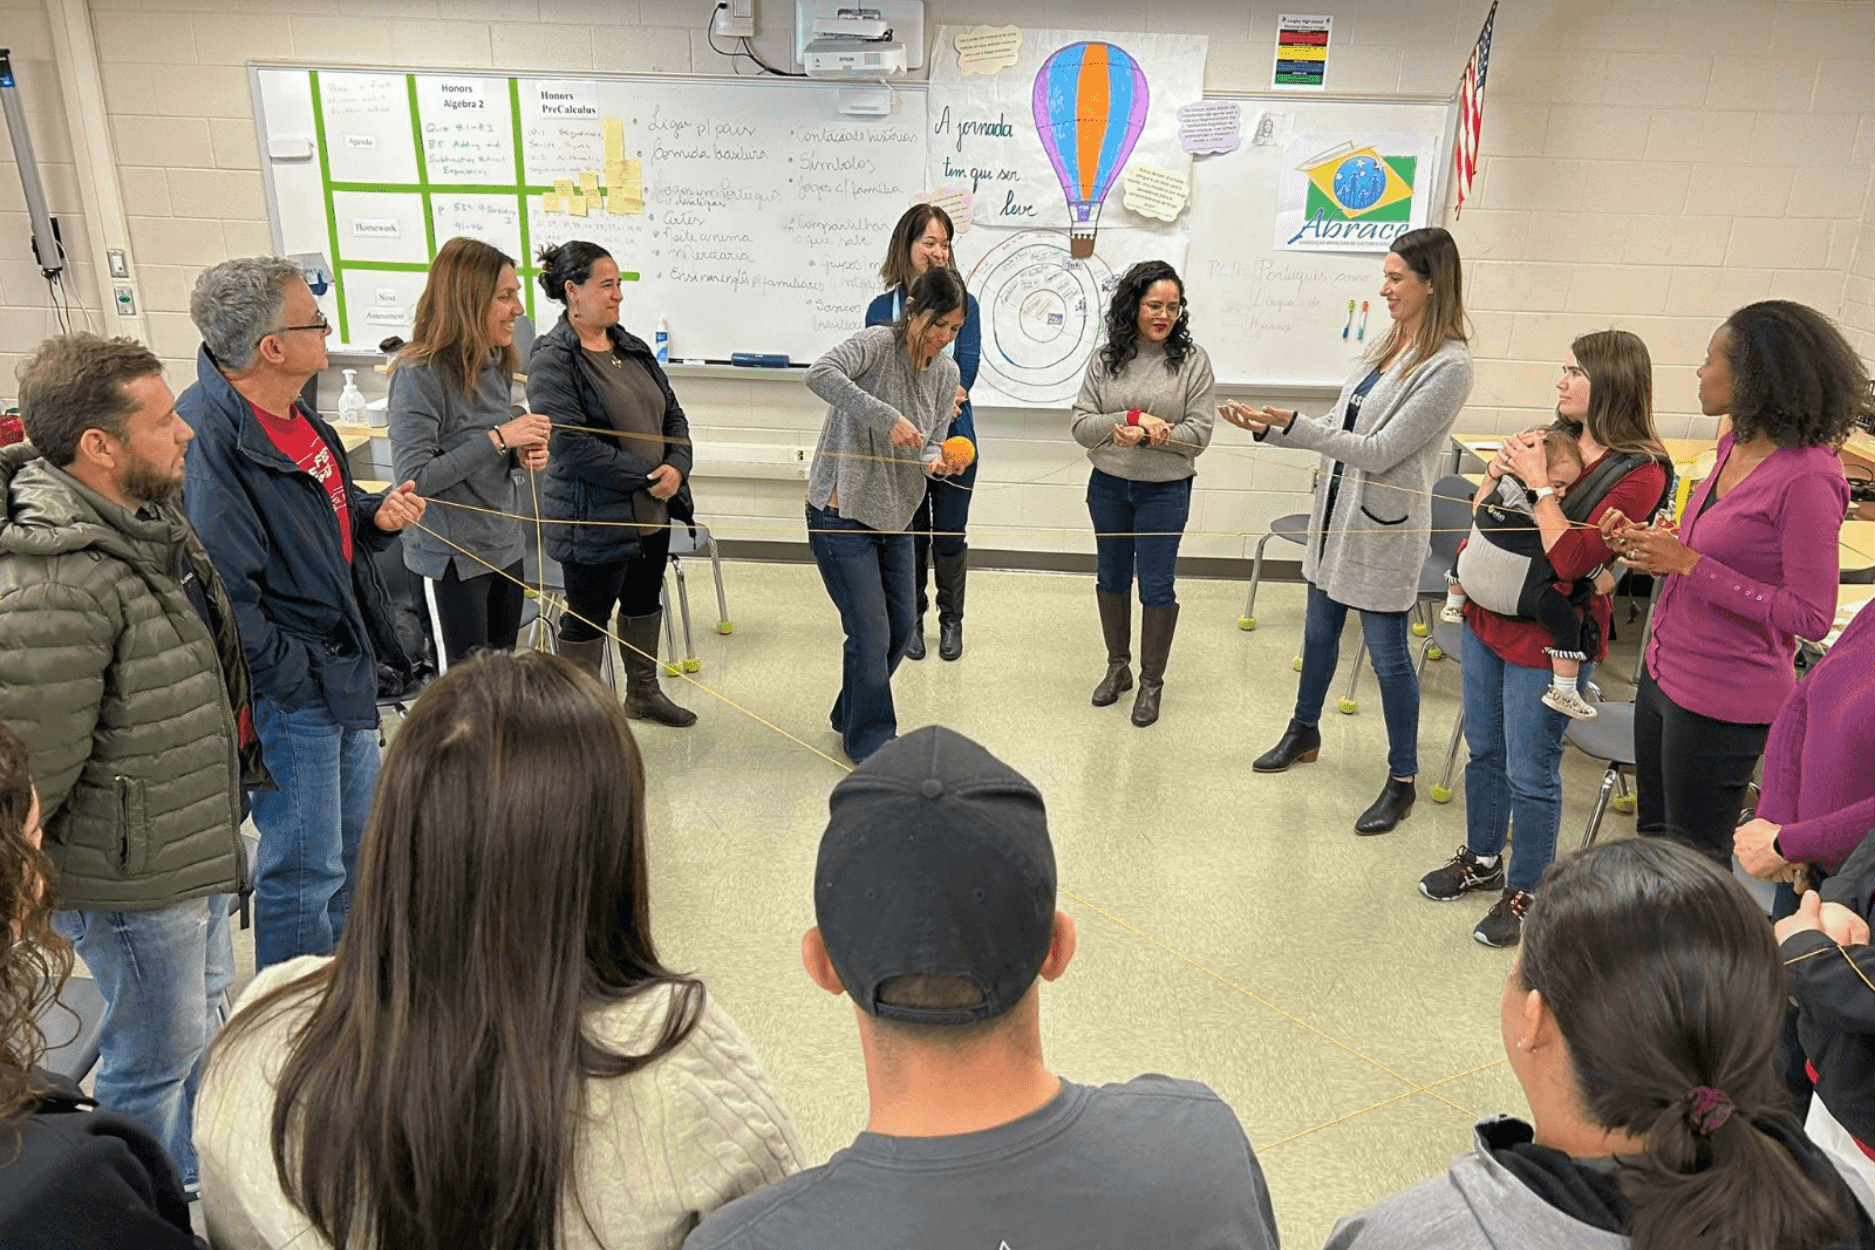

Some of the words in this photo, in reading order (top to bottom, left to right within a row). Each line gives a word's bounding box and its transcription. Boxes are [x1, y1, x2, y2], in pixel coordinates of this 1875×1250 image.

[441, 84, 473, 93] Honors
[540, 91, 574, 100] Honors
[443, 99, 477, 110] Algebra
[478, 99, 485, 108] 2
[541, 104, 596, 114] PreCalculus
[935, 105, 950, 134] A
[956, 112, 1013, 152] jornada
[348, 136, 373, 146] Agenda
[942, 156, 967, 178] tem
[970, 168, 993, 194] que
[996, 168, 1021, 182] ser
[1000, 189, 1038, 217] leve
[355, 222, 398, 233] Homework
